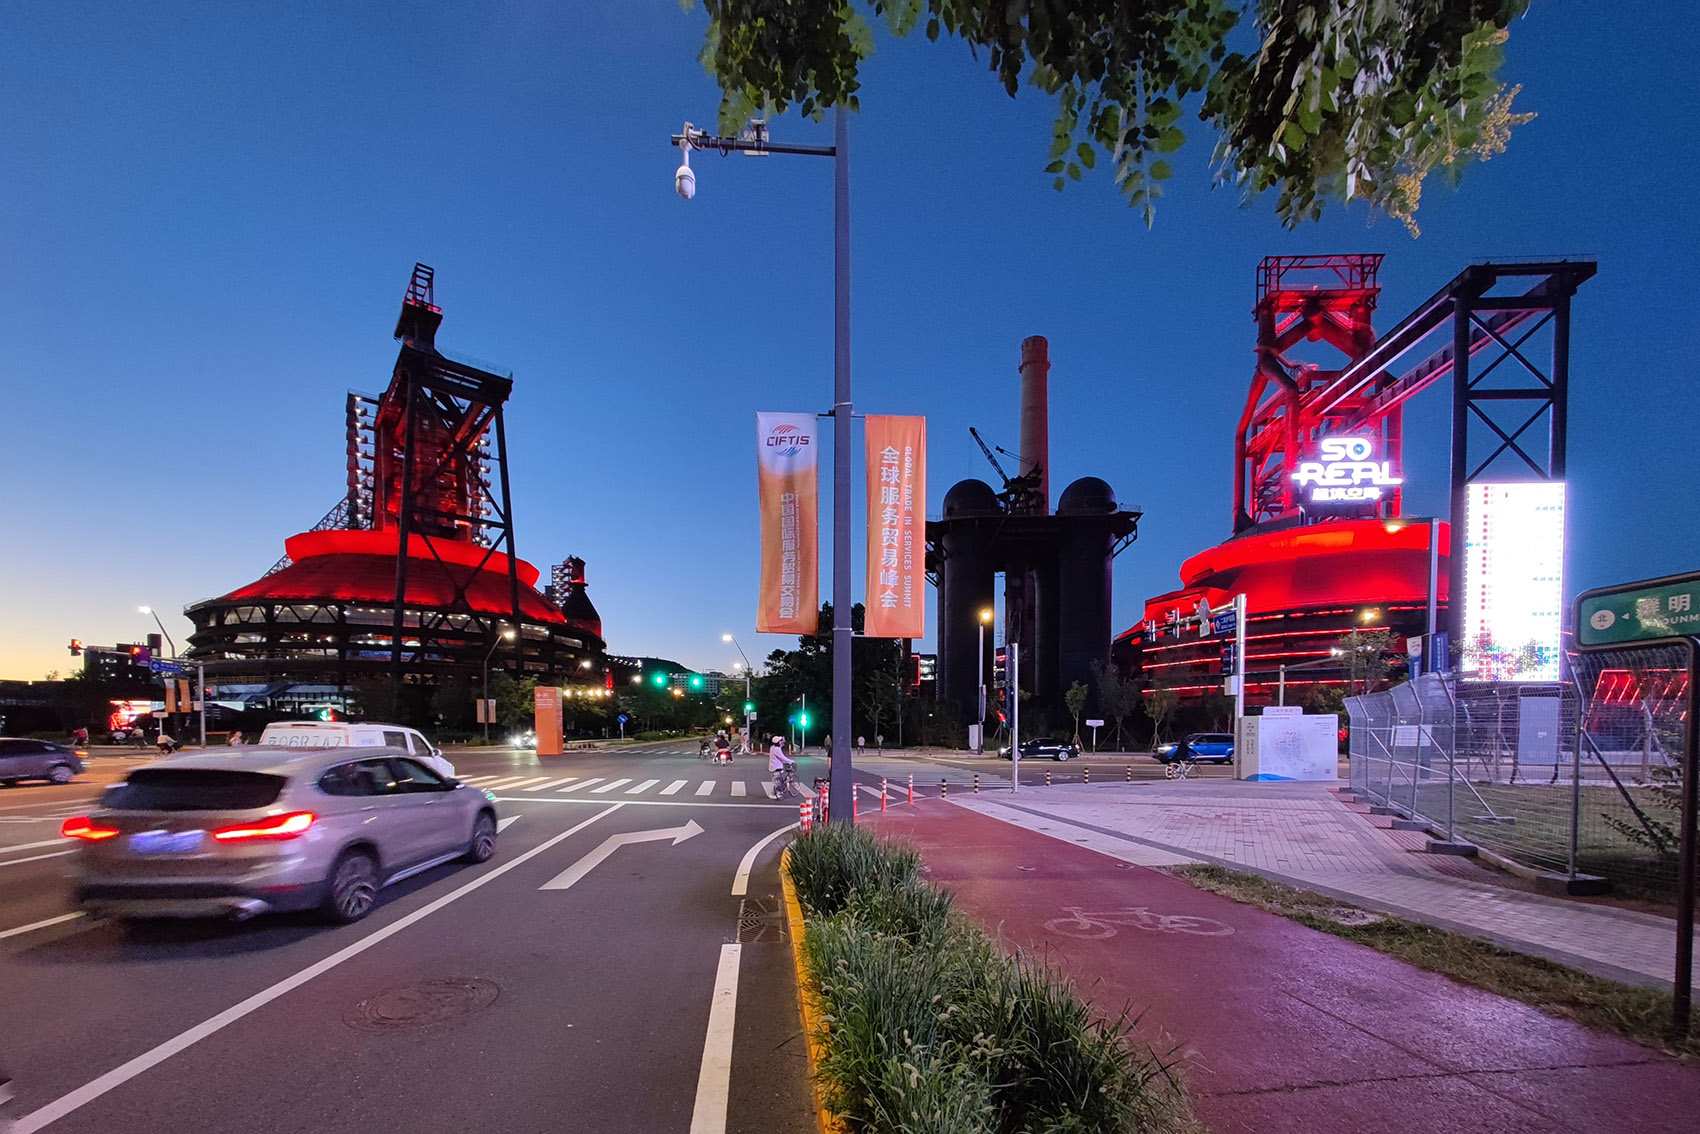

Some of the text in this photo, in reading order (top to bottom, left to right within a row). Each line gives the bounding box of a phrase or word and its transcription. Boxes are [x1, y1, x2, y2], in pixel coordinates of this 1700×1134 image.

[767, 436, 810, 446] CIFTIS
[1321, 437, 1371, 461] SO
[1292, 461, 1402, 486] REAL
[880, 445, 900, 608] 全球服务贸易峰会
[903, 446, 912, 608] GLOBAL TRADE IN SERVICES SUMMIT
[1597, 613, 1608, 622] 北
